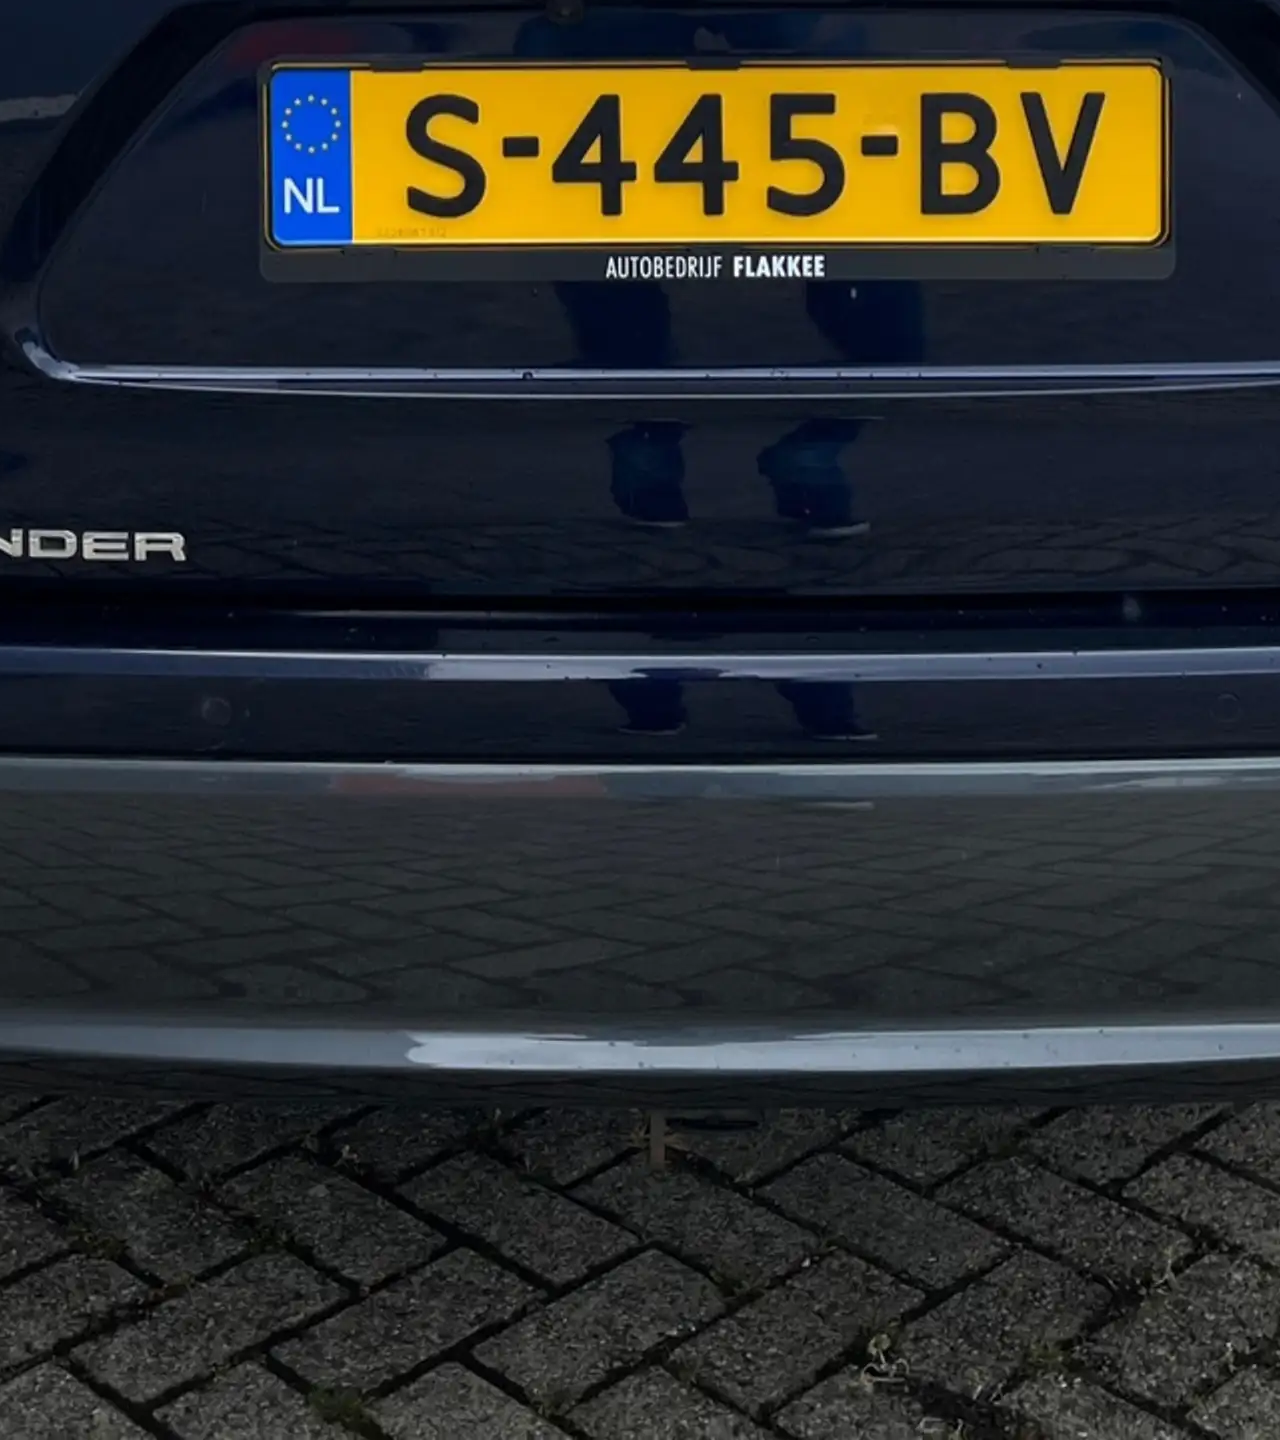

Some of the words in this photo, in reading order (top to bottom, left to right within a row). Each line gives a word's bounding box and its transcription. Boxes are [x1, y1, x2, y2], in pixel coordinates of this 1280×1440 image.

[403, 92, 1106, 218] S-445-BV
[283, 177, 340, 214] NL
[605, 255, 723, 279] AUTOBEDRIJF
[733, 255, 826, 278] FLAKKEE
